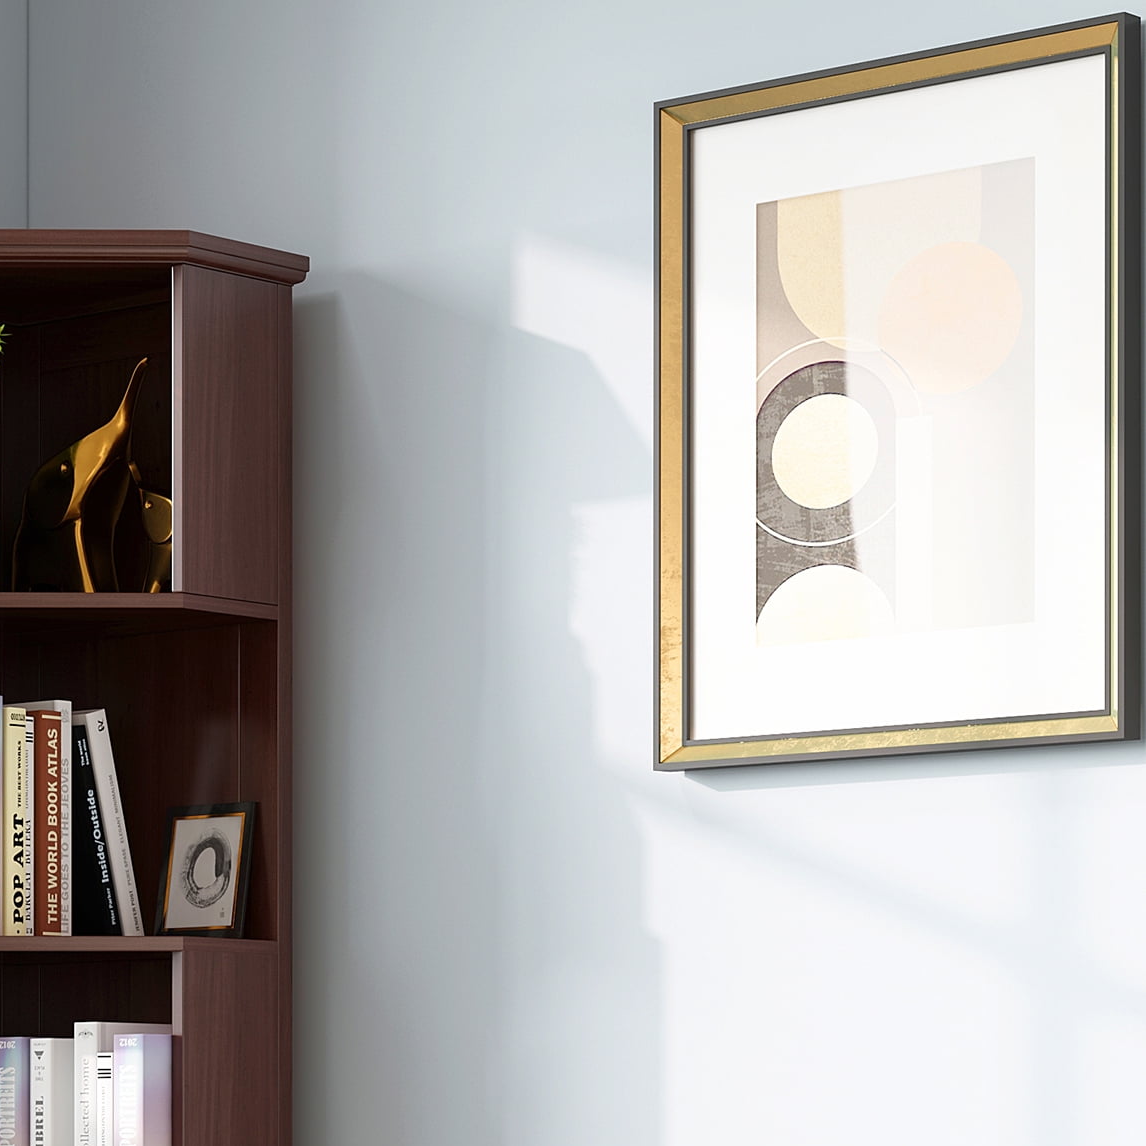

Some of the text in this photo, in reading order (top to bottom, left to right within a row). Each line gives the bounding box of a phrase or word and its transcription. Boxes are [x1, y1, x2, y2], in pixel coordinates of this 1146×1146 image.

[47, 728, 58, 924] THE WORLD BOOK ATLAS
[61, 811, 70, 838] THE
[86, 789, 110, 884] Inside/Outside
[61, 842, 70, 859] TO
[12, 813, 24, 924] POP ART
[61, 864, 70, 901] GOES
[61, 904, 70, 934] LIFE
[0, 1040, 16, 1049] 2012
[118, 1038, 138, 1047] 2012
[79, 1058, 90, 1096] home
